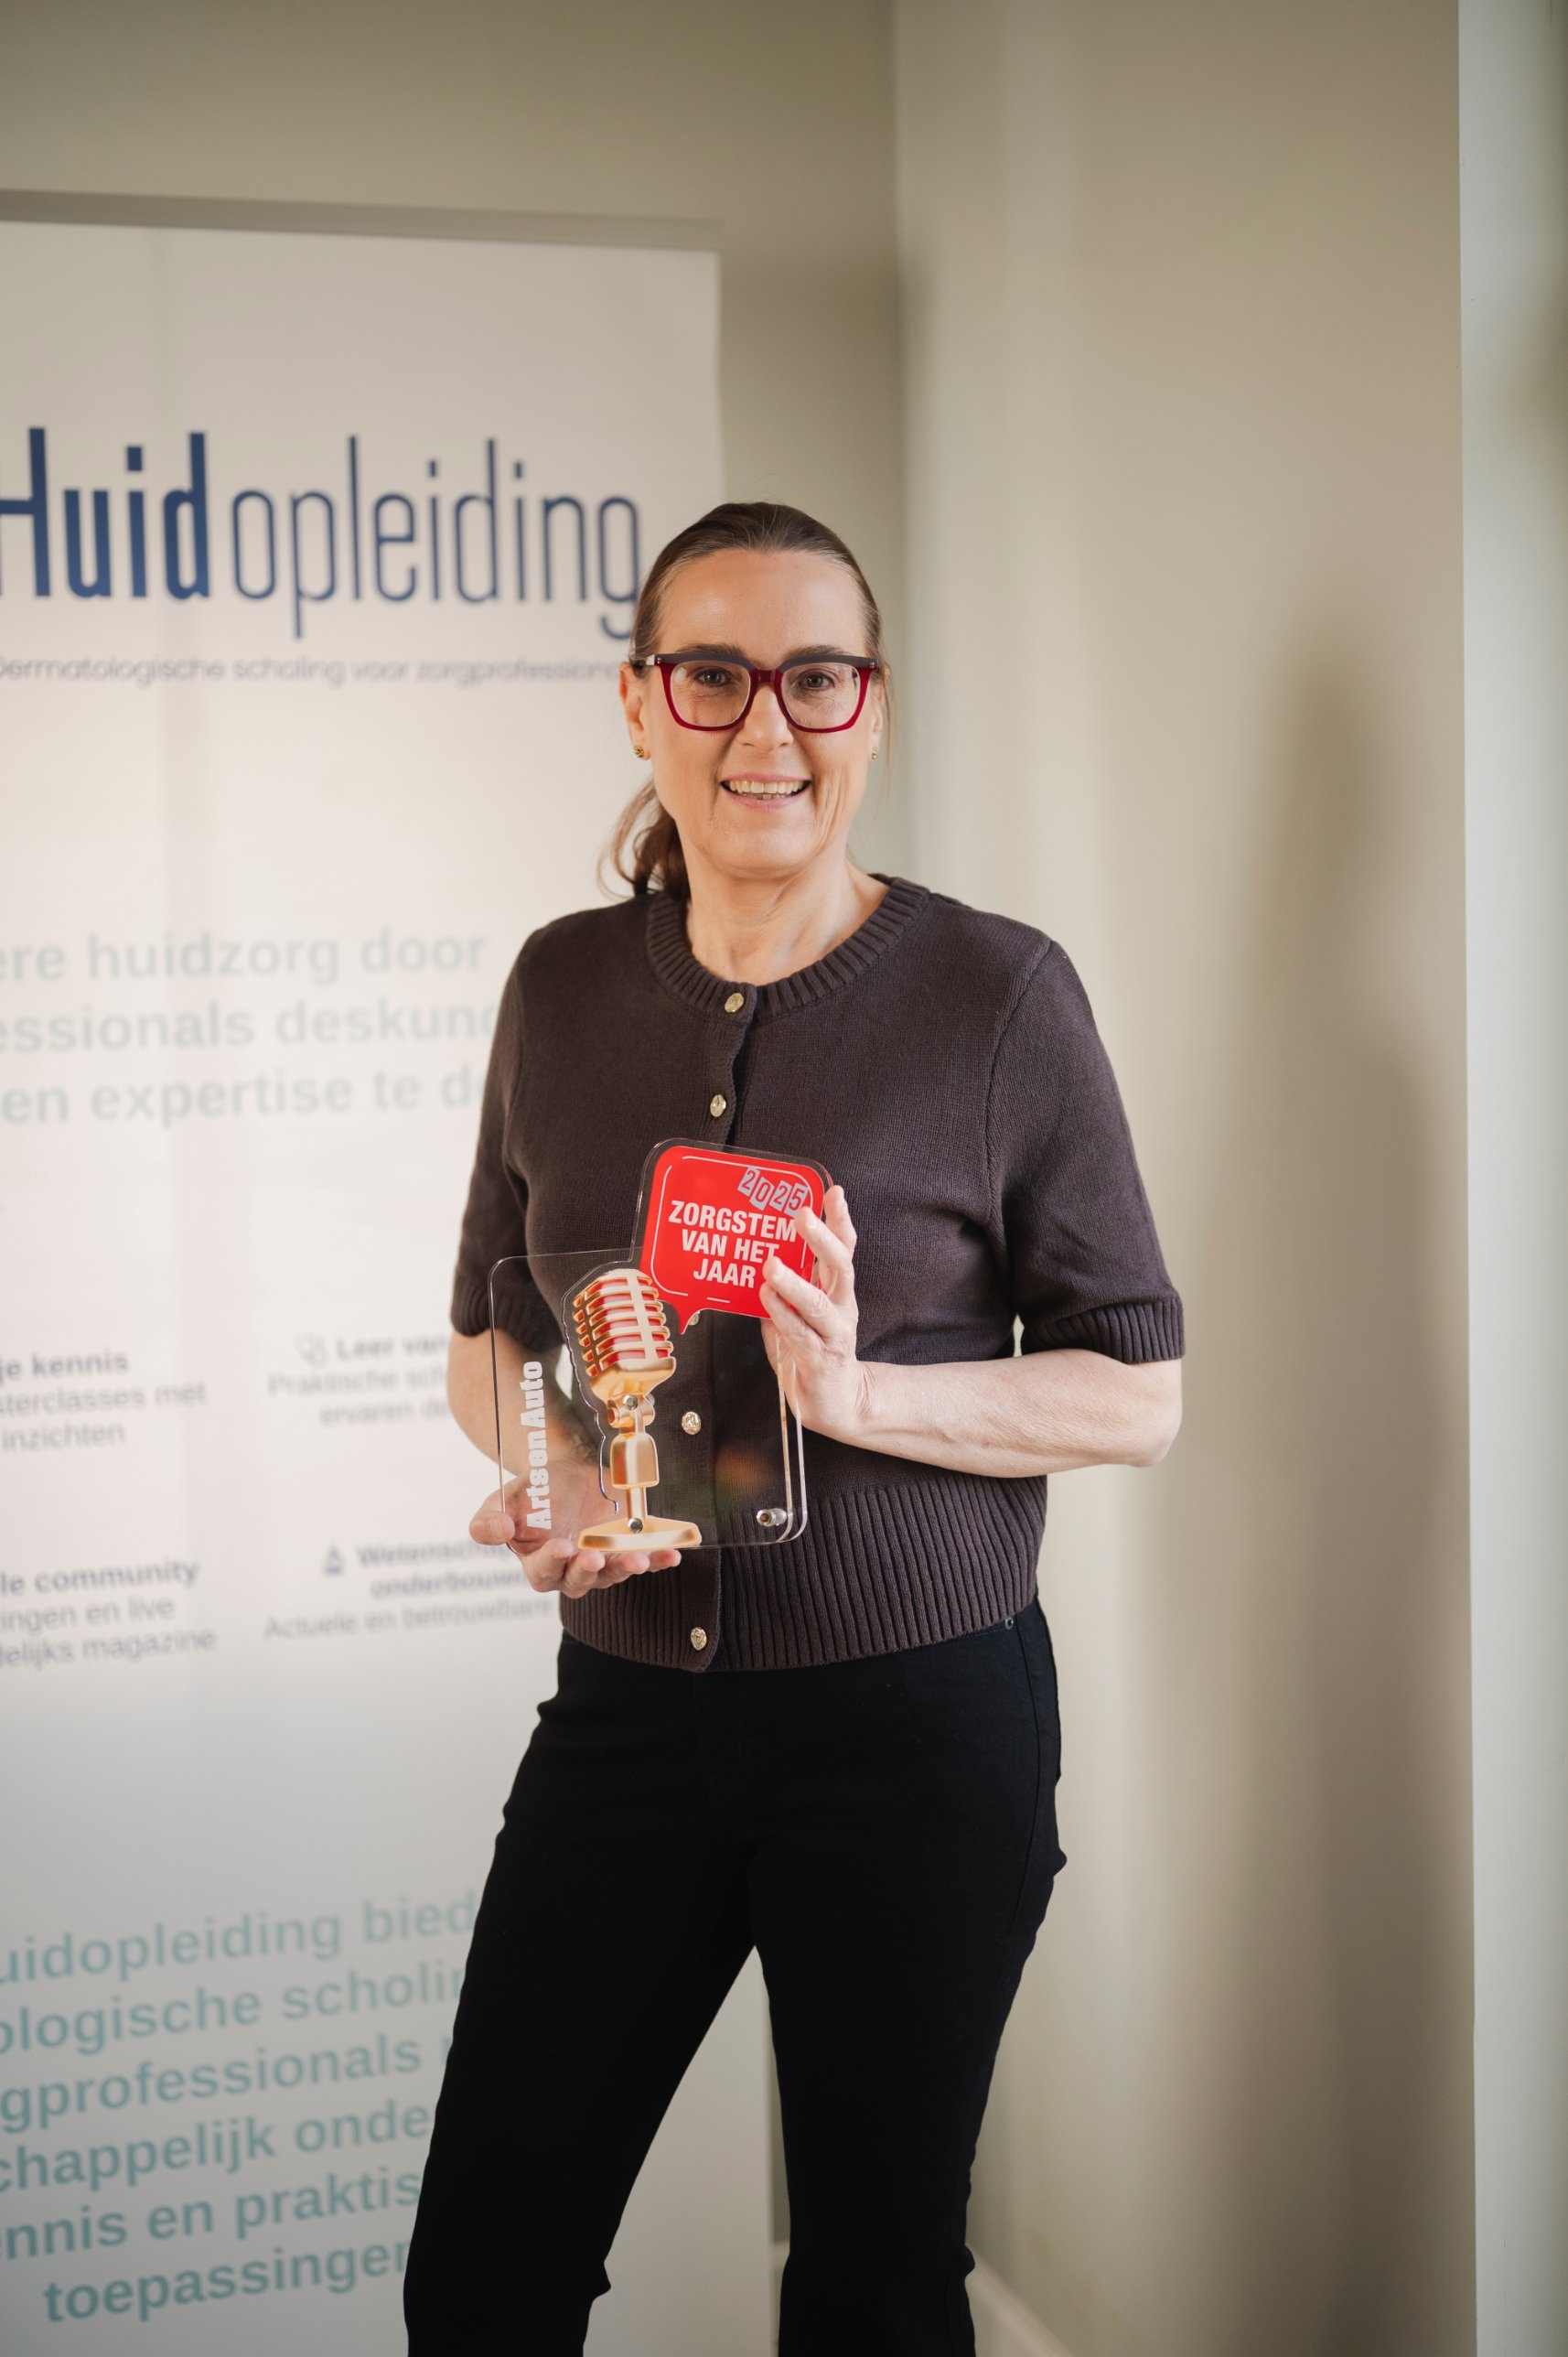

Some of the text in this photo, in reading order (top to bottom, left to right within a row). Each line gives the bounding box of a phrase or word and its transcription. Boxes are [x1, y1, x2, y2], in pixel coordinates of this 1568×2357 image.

[232, 655, 346, 687] scholing
[351, 661, 410, 683] voor
[0, 926, 488, 986] re huidzorg door
[0, 1001, 255, 1052] ssionals
[1, 1087, 70, 1125] en
[91, 1069, 355, 1130] expertise
[373, 1070, 422, 1112] te
[740, 1168, 806, 1213] 2025
[668, 1200, 797, 1243] ZORGSTEM
[682, 1229, 779, 1264] VAN HET
[693, 1258, 757, 1288] JAAR
[31, 1348, 129, 1378] kennis
[155, 1381, 209, 1408] met
[2, 1422, 126, 1452] inzichten
[520, 1361, 552, 1530] ArtsenAuto
[35, 1557, 200, 1591] community
[85, 1603, 120, 1626] en
[127, 1595, 175, 1623] live
[82, 1628, 218, 1663] magazine
[0, 2032, 422, 2134] gprofessionals
[295, 2099, 431, 2152] onde
[0, 2166, 421, 2260] nnis en praktis
